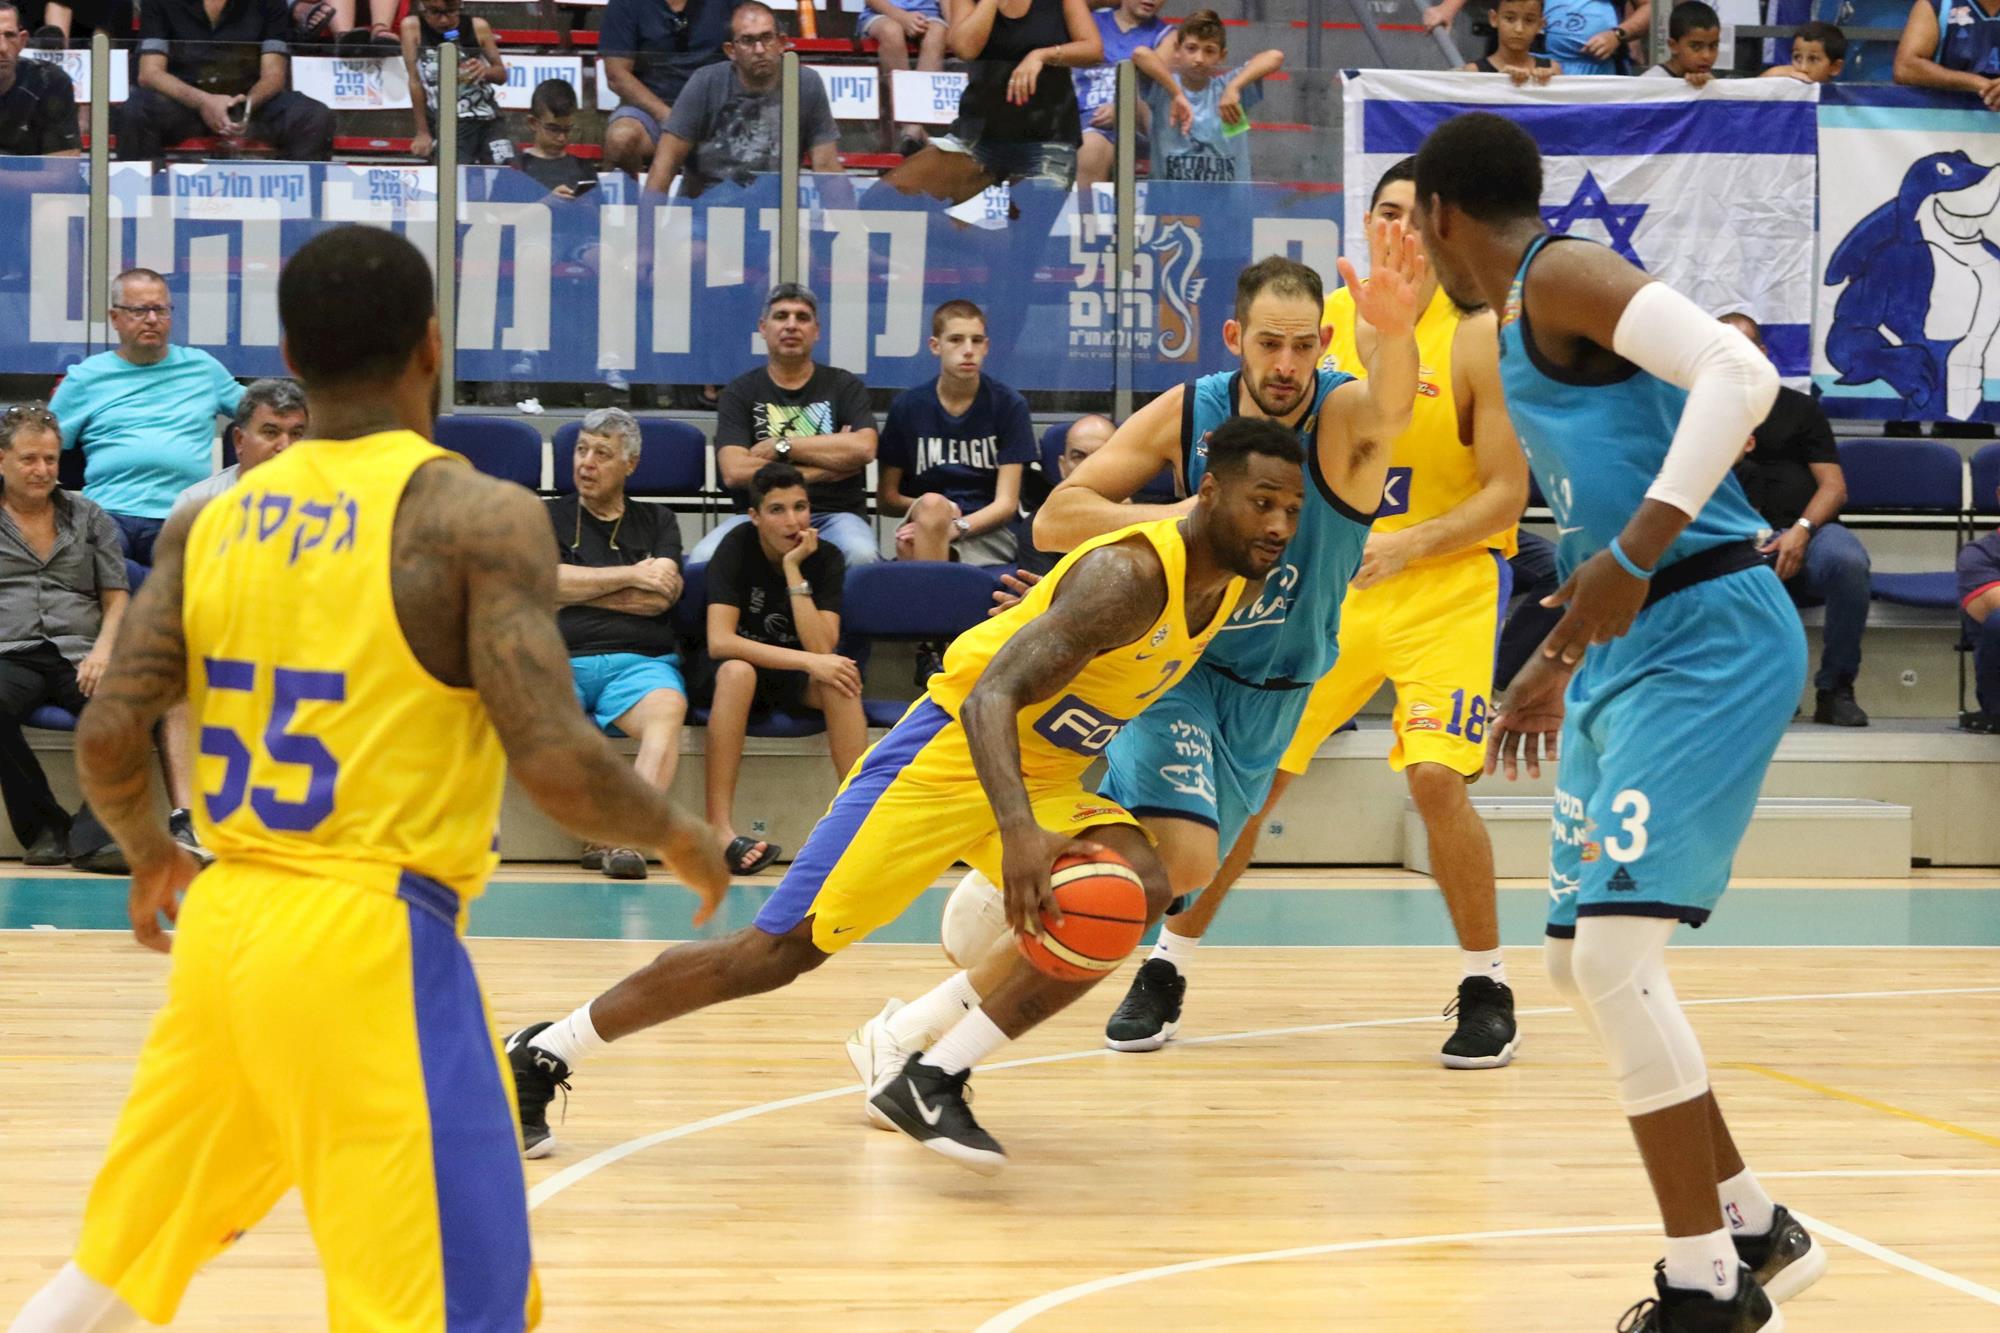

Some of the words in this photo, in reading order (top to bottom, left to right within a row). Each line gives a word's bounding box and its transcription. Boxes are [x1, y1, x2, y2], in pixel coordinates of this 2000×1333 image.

[507, 63, 526, 87] מו
[931, 76, 962, 88] קניון
[335, 85, 365, 96] הים
[832, 76, 872, 102] קניון
[176, 174, 212, 197] הים
[218, 171, 253, 198] מול
[260, 174, 304, 202] קניון
[370, 181, 402, 194] מול
[1068, 214, 1156, 252] קון
[1069, 291, 1153, 328] הים
[1050, 708, 1119, 750] FO
[1446, 688, 1486, 744] 18
[200, 656, 346, 832] 55
[1604, 788, 1651, 863] 3
